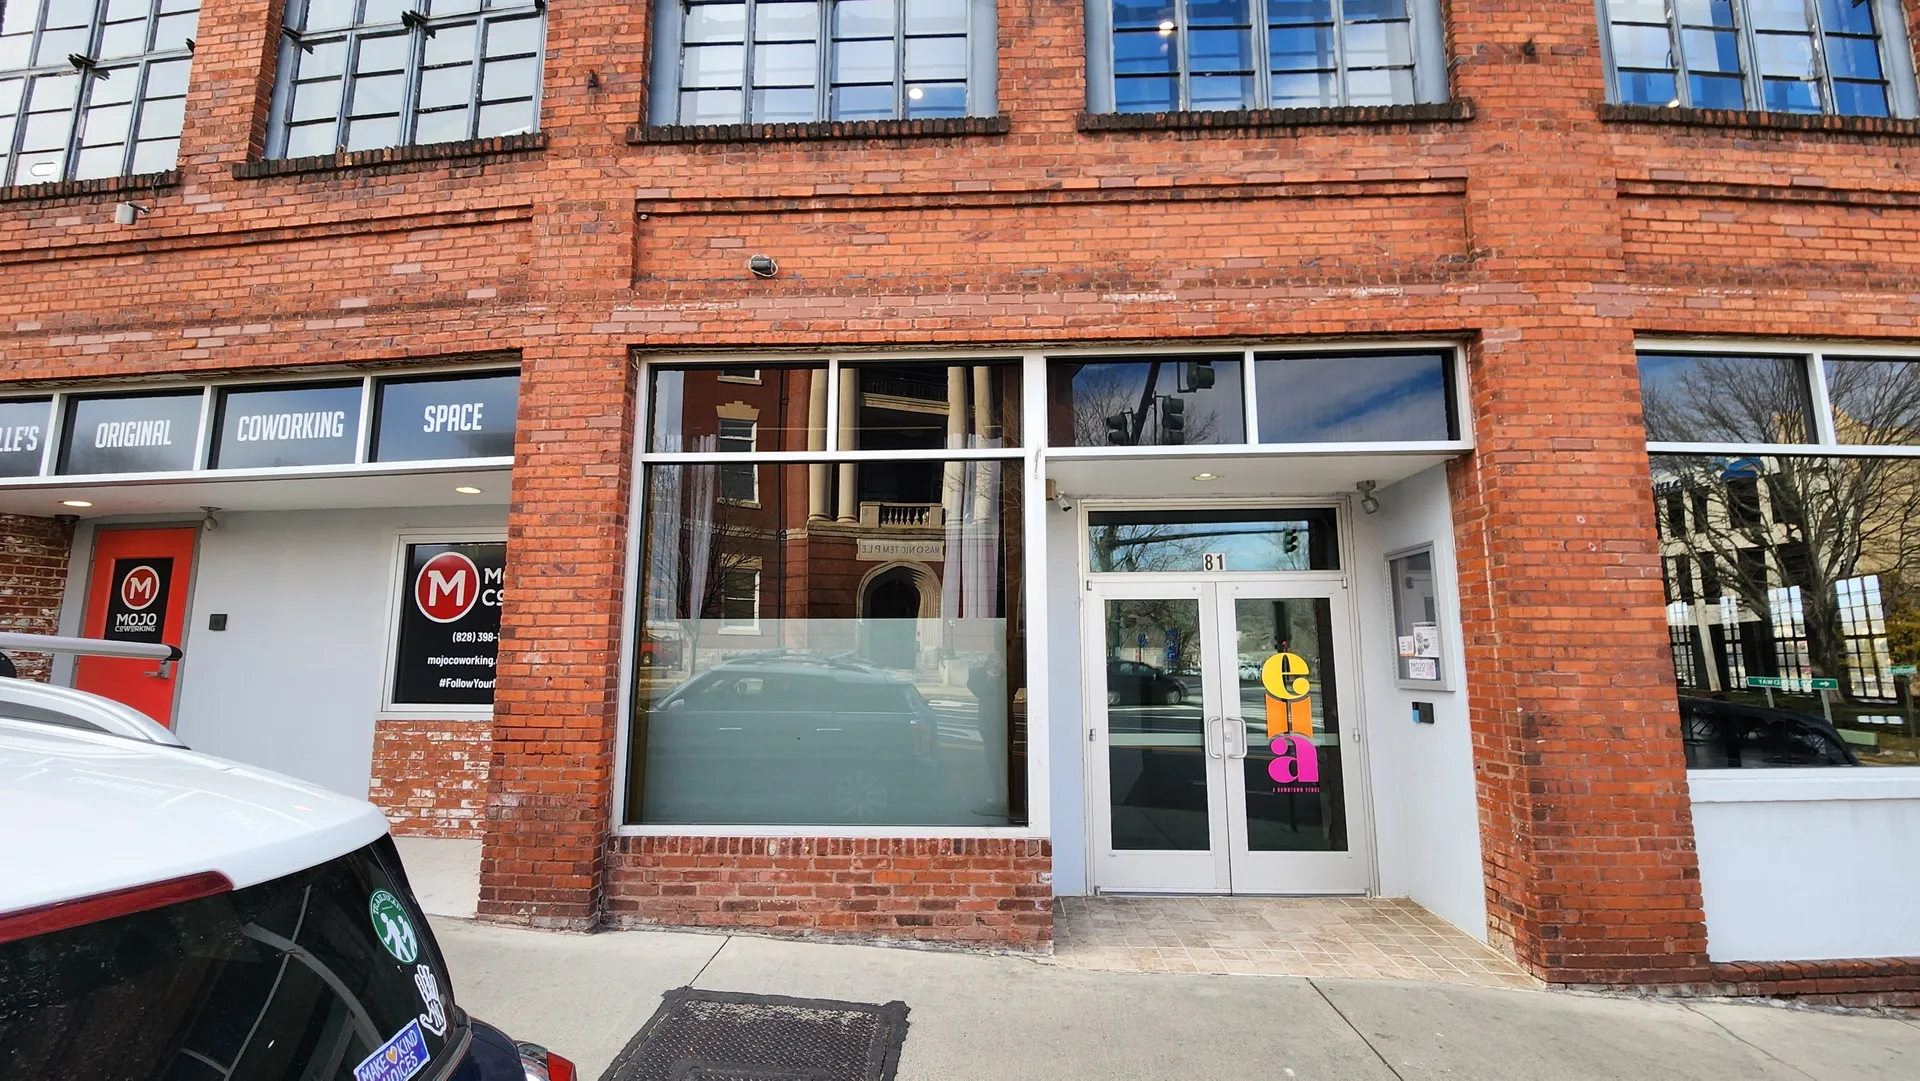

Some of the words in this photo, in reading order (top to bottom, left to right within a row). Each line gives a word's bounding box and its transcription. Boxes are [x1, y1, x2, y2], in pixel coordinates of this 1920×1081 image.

[95, 420, 172, 449] ORIGINAL
[237, 410, 345, 442] COWORKING
[423, 403, 484, 433] SPACE
[1205, 554, 1223, 570] 81
[484, 567, 505, 585] M
[116, 613, 157, 626] MOJO
[115, 625, 156, 633] COWORKING
[452, 631, 476, 643] (828)
[439, 677, 496, 689] #FollowYour
[396, 1029, 418, 1058] KIND
